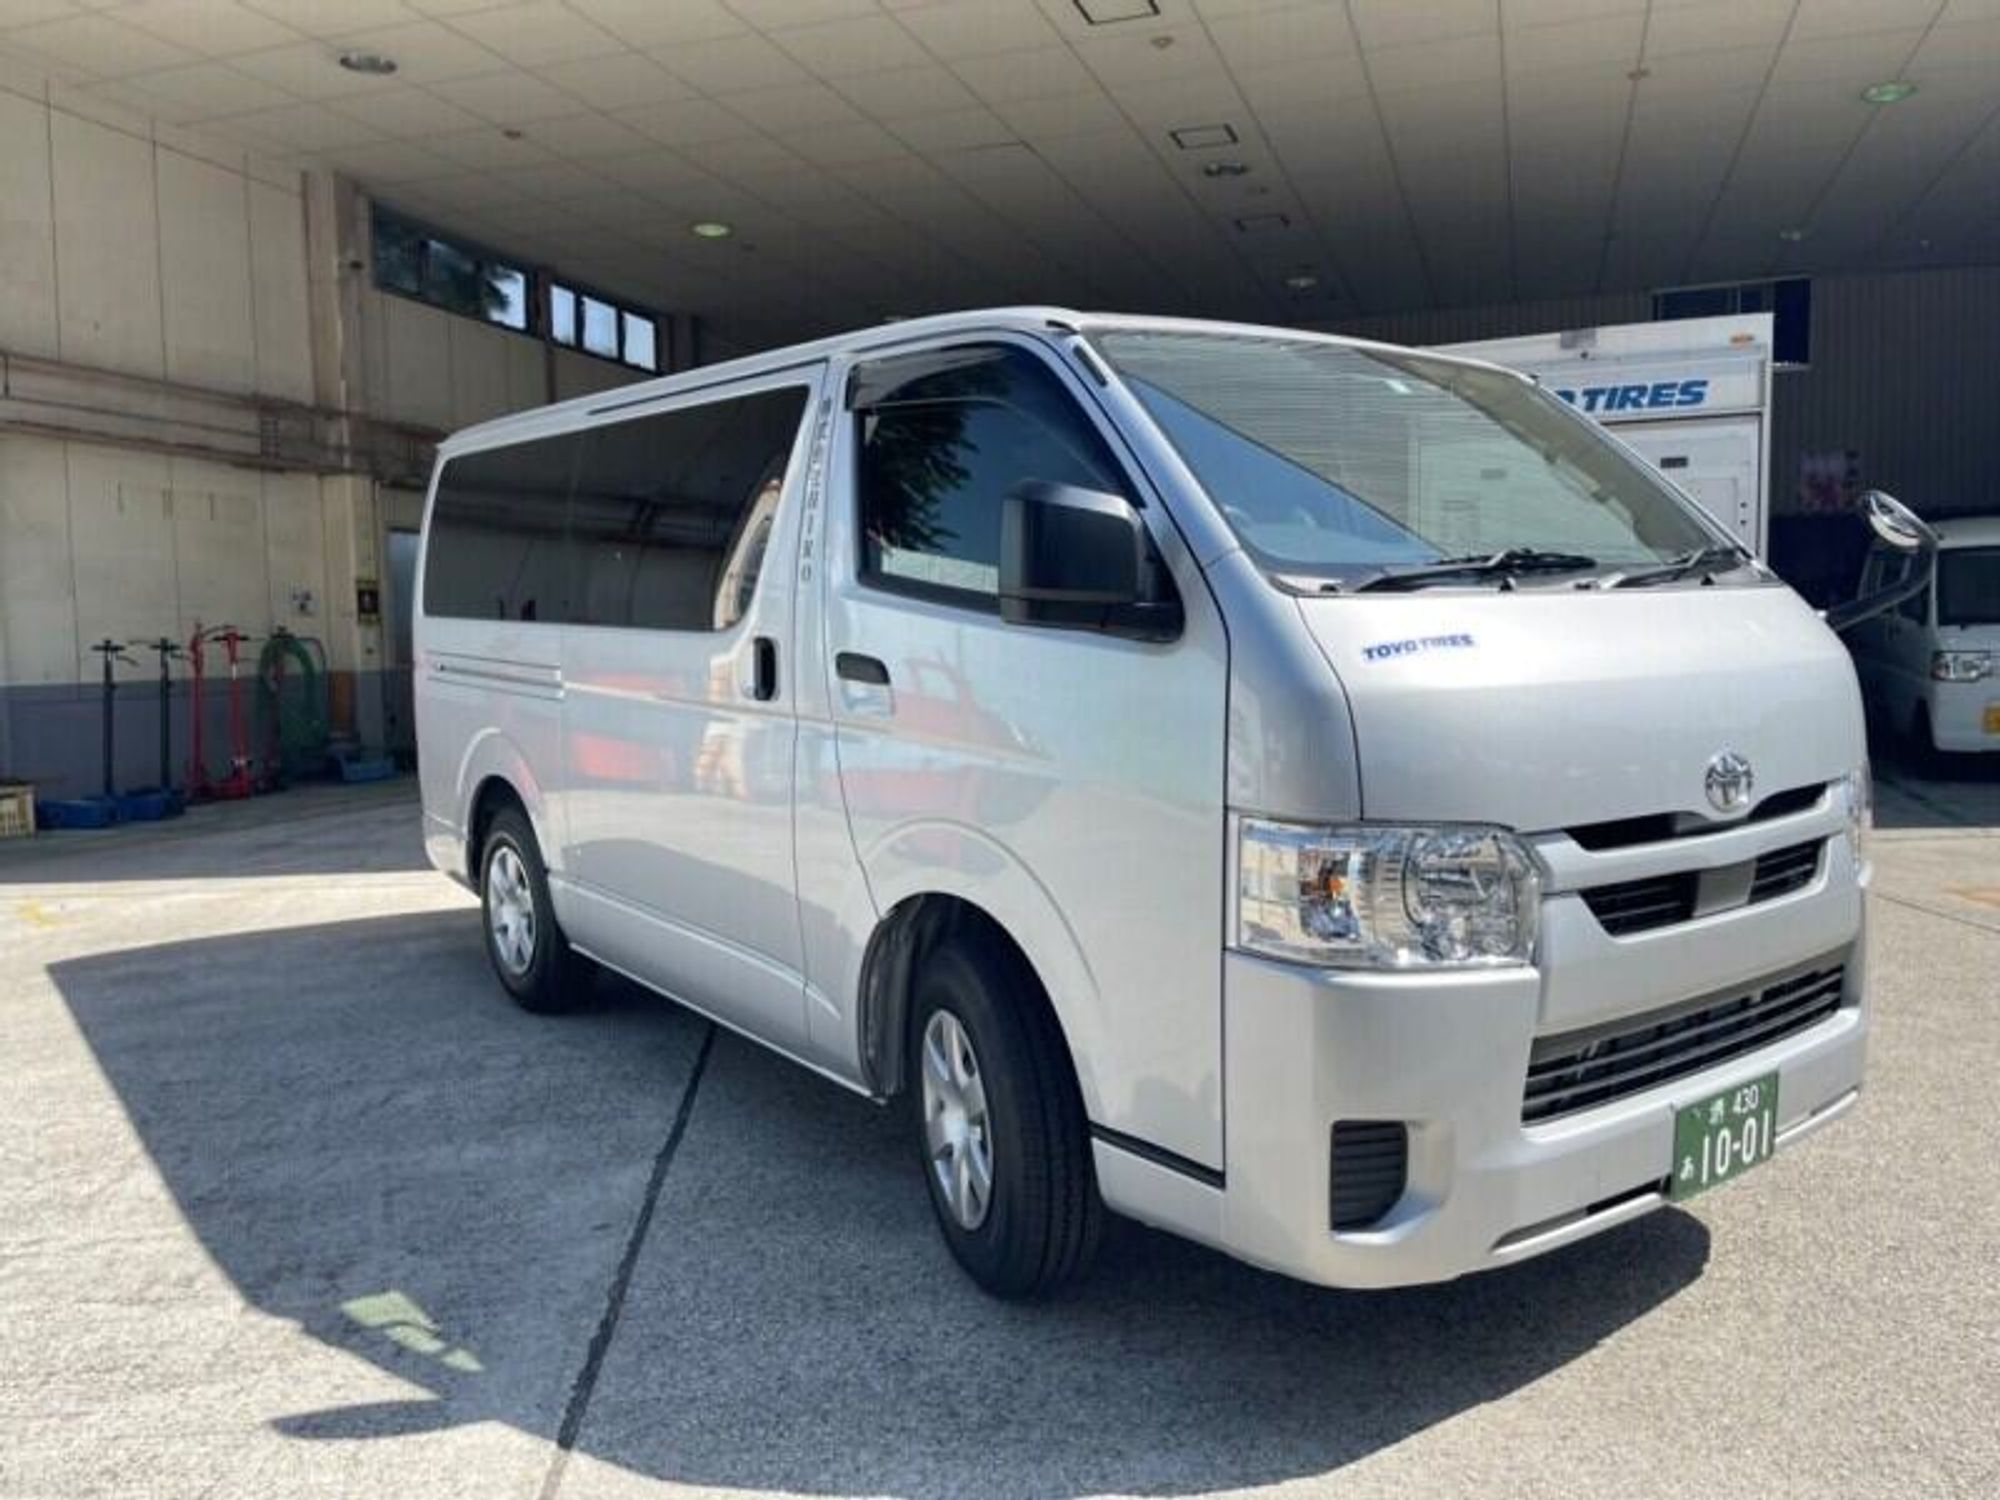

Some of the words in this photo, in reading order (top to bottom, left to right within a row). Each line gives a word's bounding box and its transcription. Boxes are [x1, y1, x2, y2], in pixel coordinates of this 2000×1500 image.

[1582, 379, 1709, 412] TIRES
[1363, 639, 1418, 660] TOYO
[1732, 1084, 1759, 1114] 430
[1701, 1108, 1770, 1184] 10-01
